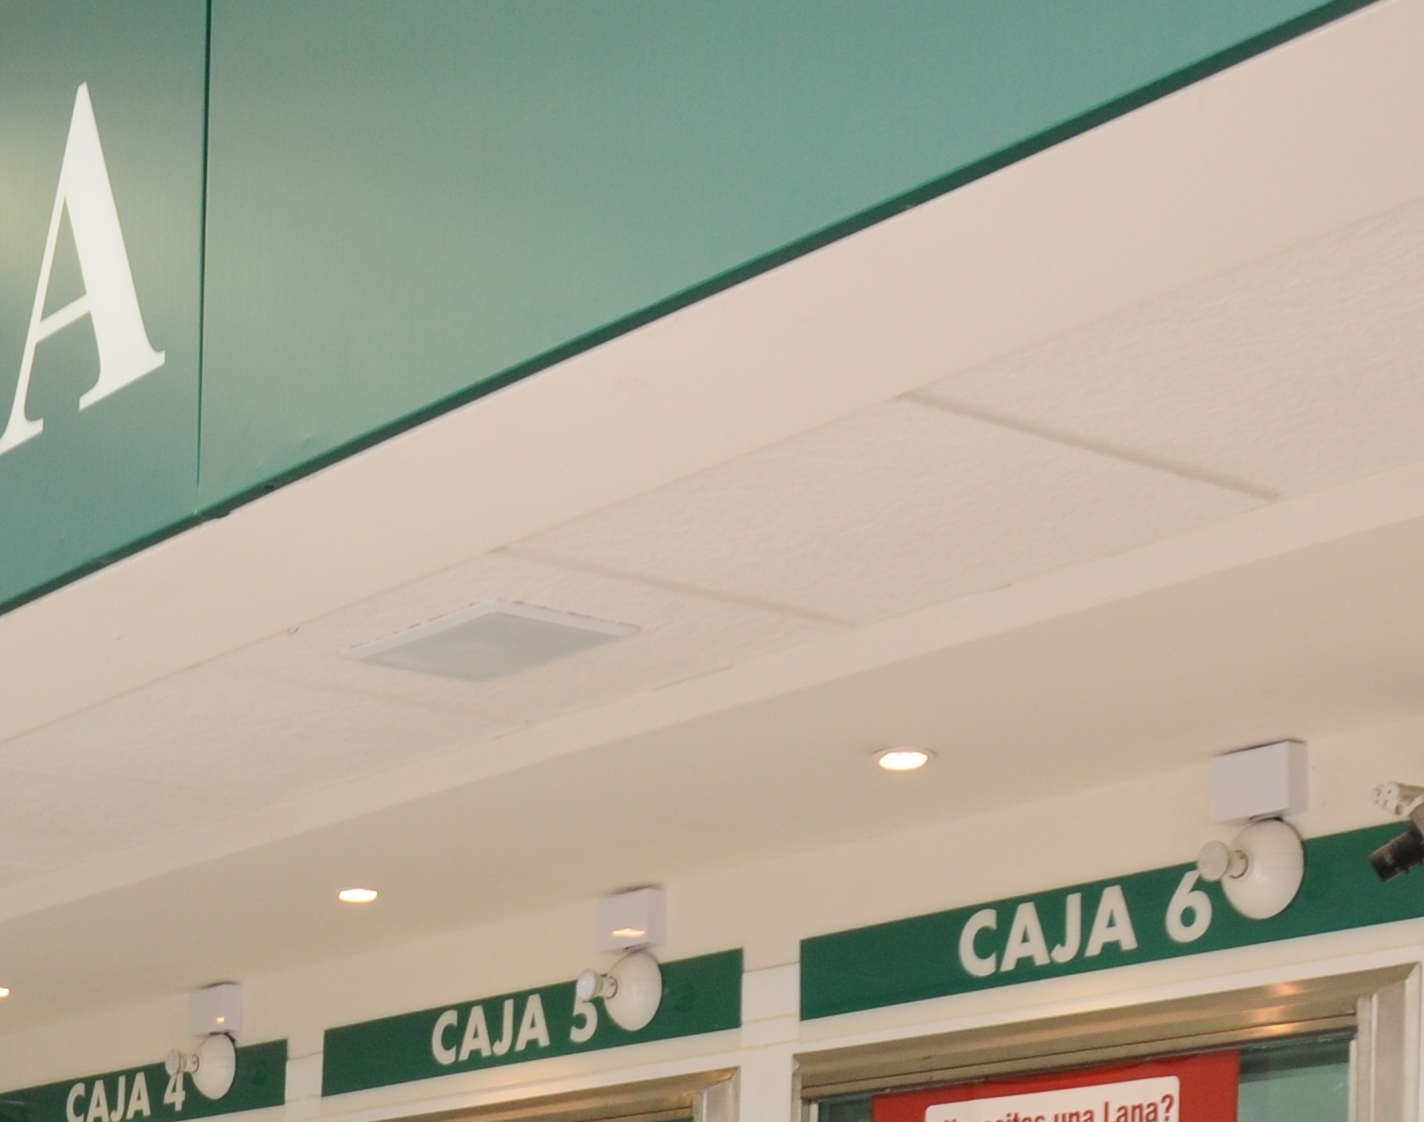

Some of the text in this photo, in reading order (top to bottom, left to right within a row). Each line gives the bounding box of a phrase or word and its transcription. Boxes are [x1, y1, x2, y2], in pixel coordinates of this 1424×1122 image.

[959, 869, 1213, 977] CAJA 6
[432, 986, 598, 1065] CAJA 5
[164, 1070, 185, 1112] 4
